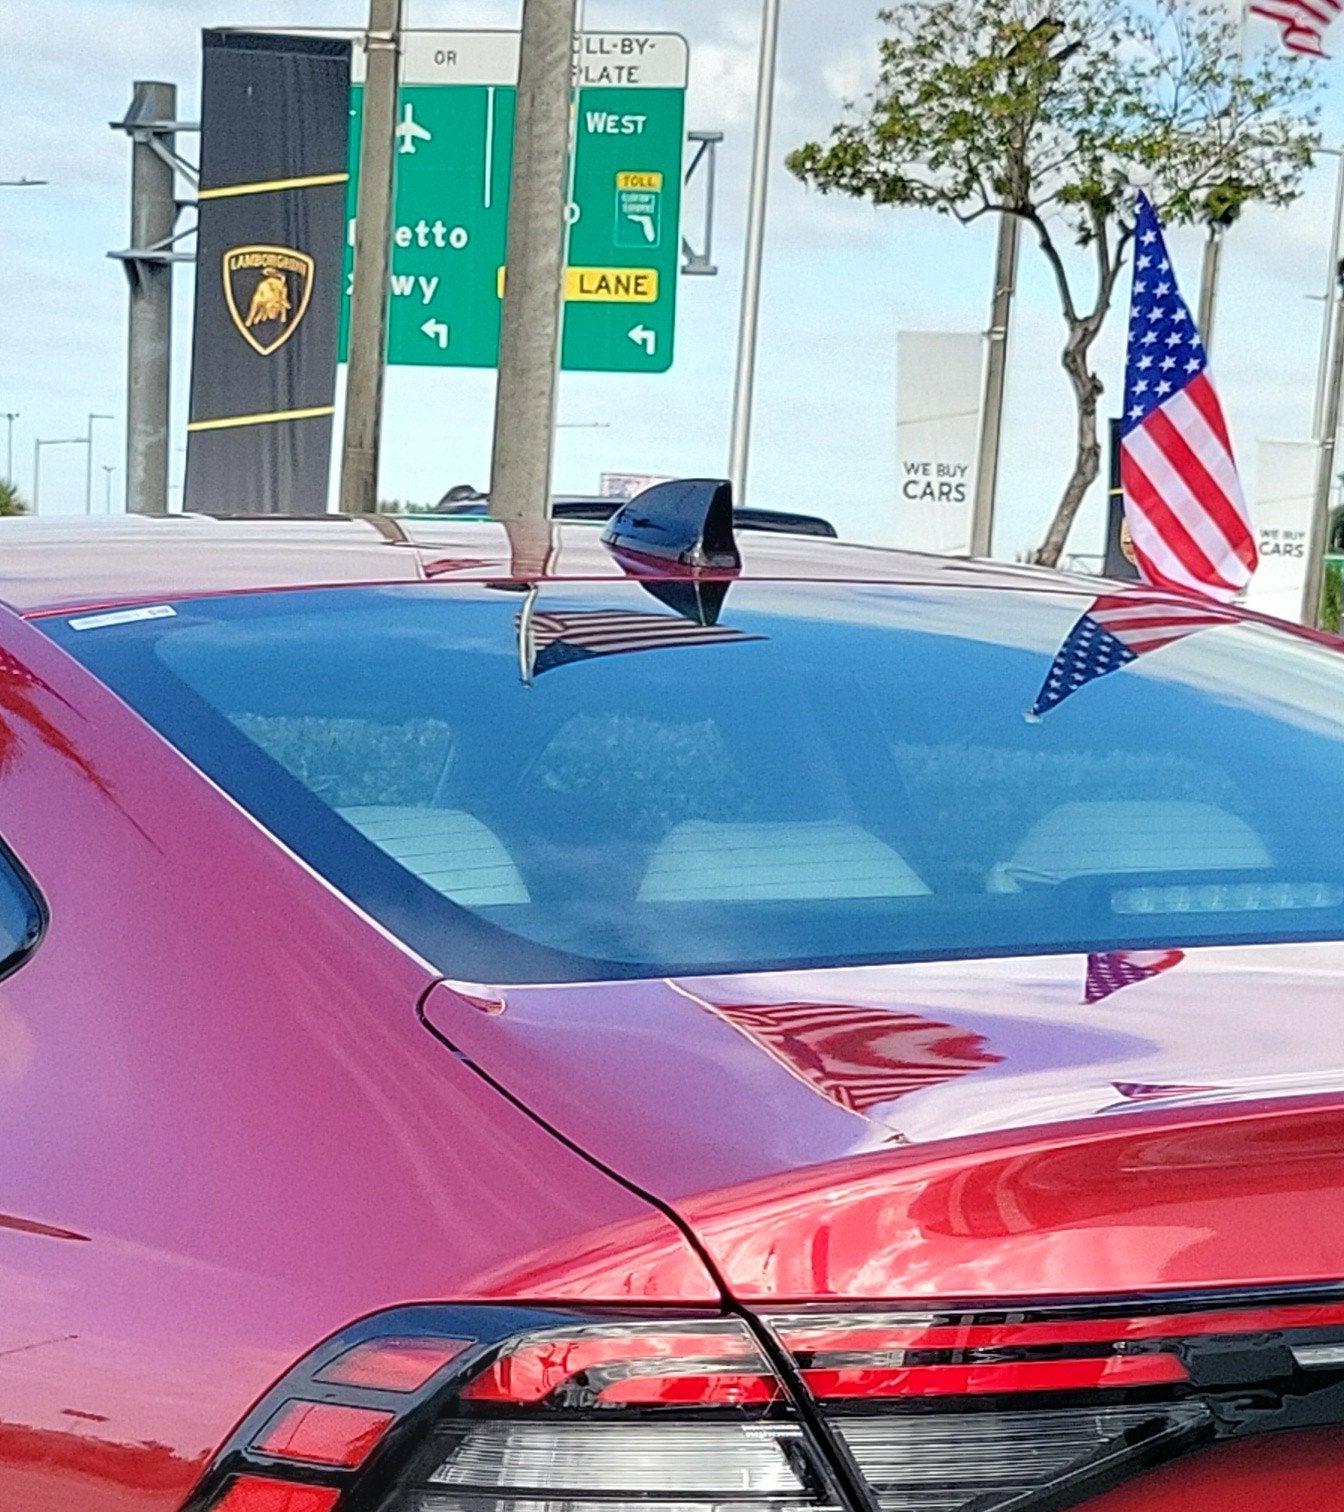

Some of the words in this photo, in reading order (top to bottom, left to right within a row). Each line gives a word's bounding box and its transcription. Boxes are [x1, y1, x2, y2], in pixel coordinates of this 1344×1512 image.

[572, 37, 655, 55] OLL-BY-
[434, 50, 457, 66] OR
[586, 111, 647, 134] WEST
[579, 273, 648, 296] LANE
[903, 461, 931, 476] WE
[937, 463, 968, 478] BUY
[903, 480, 966, 502] CARS
[1259, 541, 1305, 558] CARS
